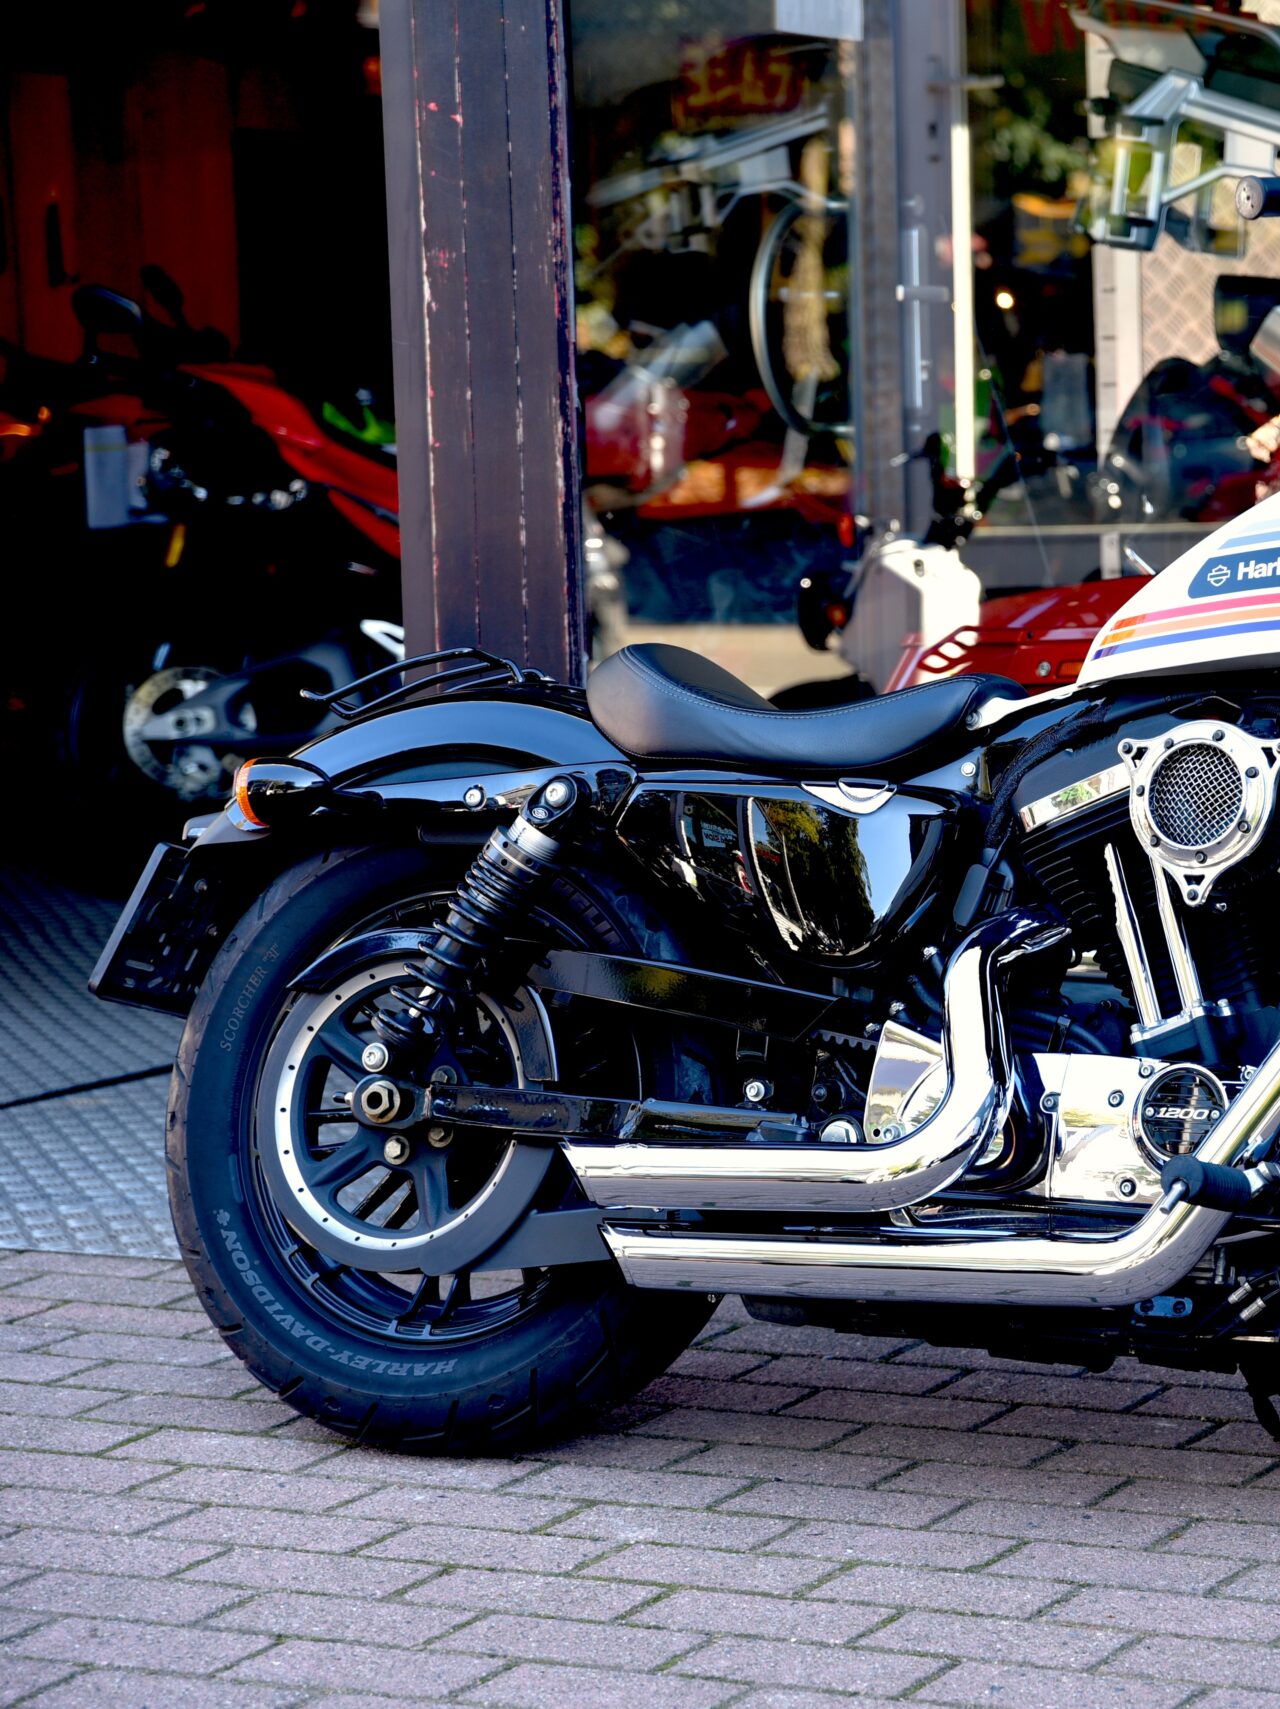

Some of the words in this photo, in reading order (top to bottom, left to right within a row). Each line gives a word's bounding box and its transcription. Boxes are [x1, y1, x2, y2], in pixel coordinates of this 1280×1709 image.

[220, 965, 269, 1052] SCORCHER
[1156, 1107, 1210, 1120] 1200
[220, 1228, 459, 1377] HARLEY-DAVIDSON
